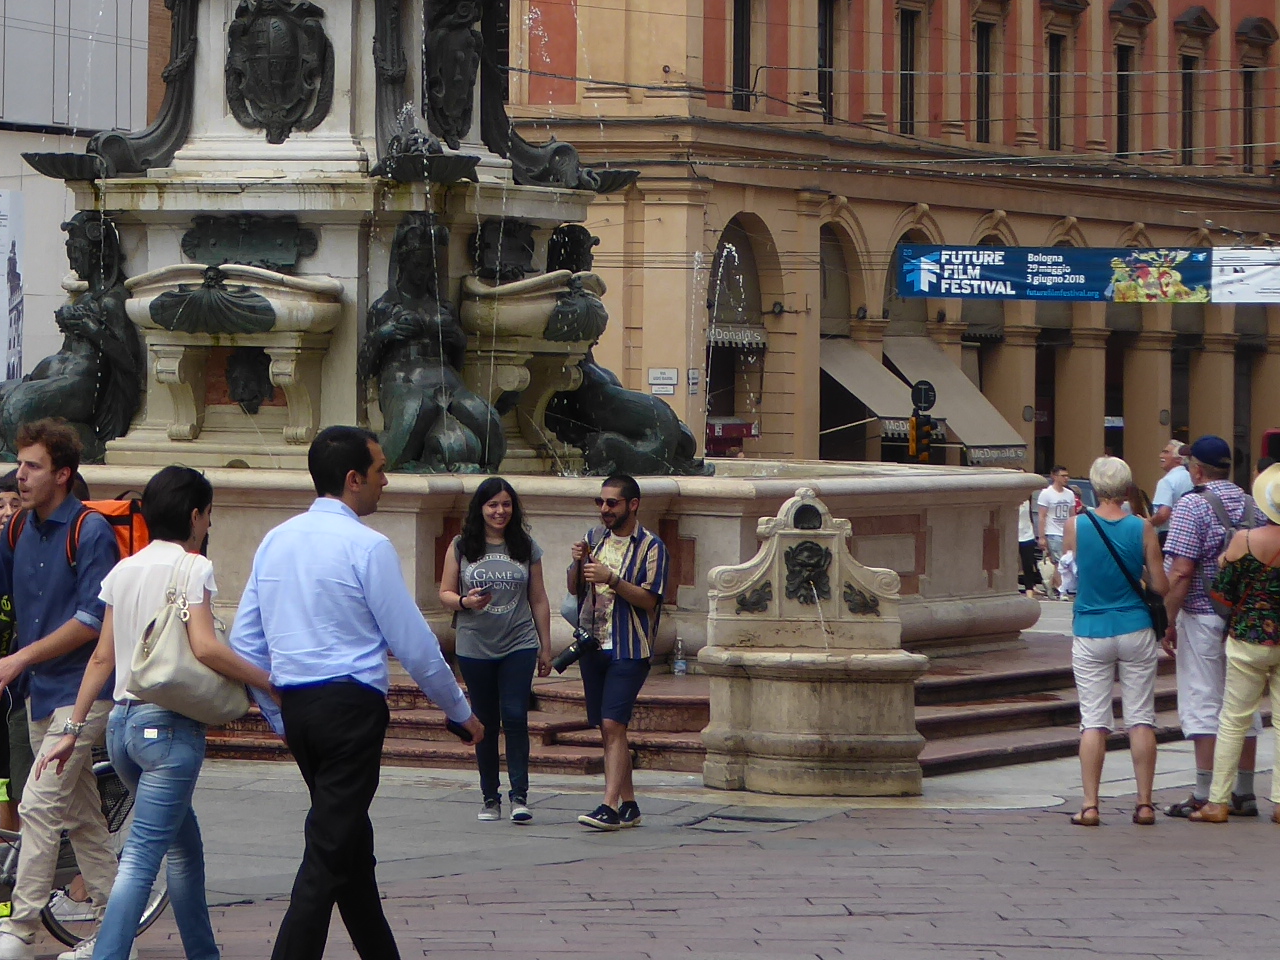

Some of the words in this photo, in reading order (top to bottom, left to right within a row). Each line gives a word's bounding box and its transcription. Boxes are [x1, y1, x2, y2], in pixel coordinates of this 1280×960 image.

[941, 250, 1005, 265] FUTURE
[1027, 252, 1064, 264] Bologna
[943, 265, 981, 279] FILM
[1026, 263, 1038, 273] 29
[1038, 263, 1071, 275] maggio
[1026, 274, 1032, 283] 3
[1032, 274, 1064, 285] giugno
[1064, 274, 1086, 284] 2018
[941, 279, 1016, 295] FESTIVAL
[971, 447, 1024, 459] McDonald's
